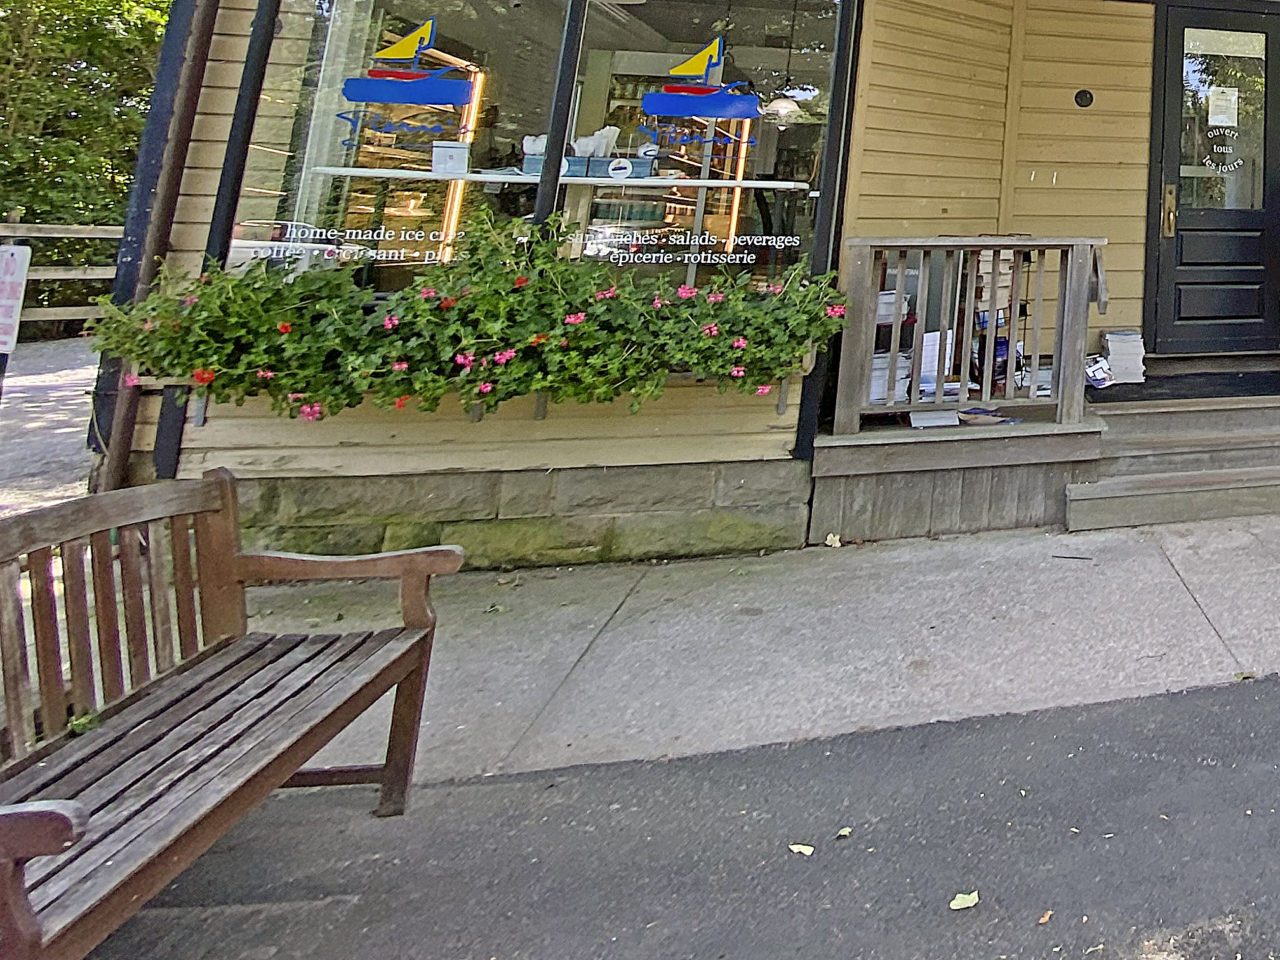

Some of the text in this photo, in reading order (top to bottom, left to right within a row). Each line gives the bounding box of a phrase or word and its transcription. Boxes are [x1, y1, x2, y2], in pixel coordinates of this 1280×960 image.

[1207, 127, 1240, 141] ouvert
[1213, 144, 1233, 154] tous
[1202, 154, 1244, 175] les jours
[284, 223, 395, 241] home-made
[400, 226, 426, 242] ice
[668, 231, 718, 247] salads
[730, 231, 801, 248] beverages
[683, 248, 756, 264] rotisserie
